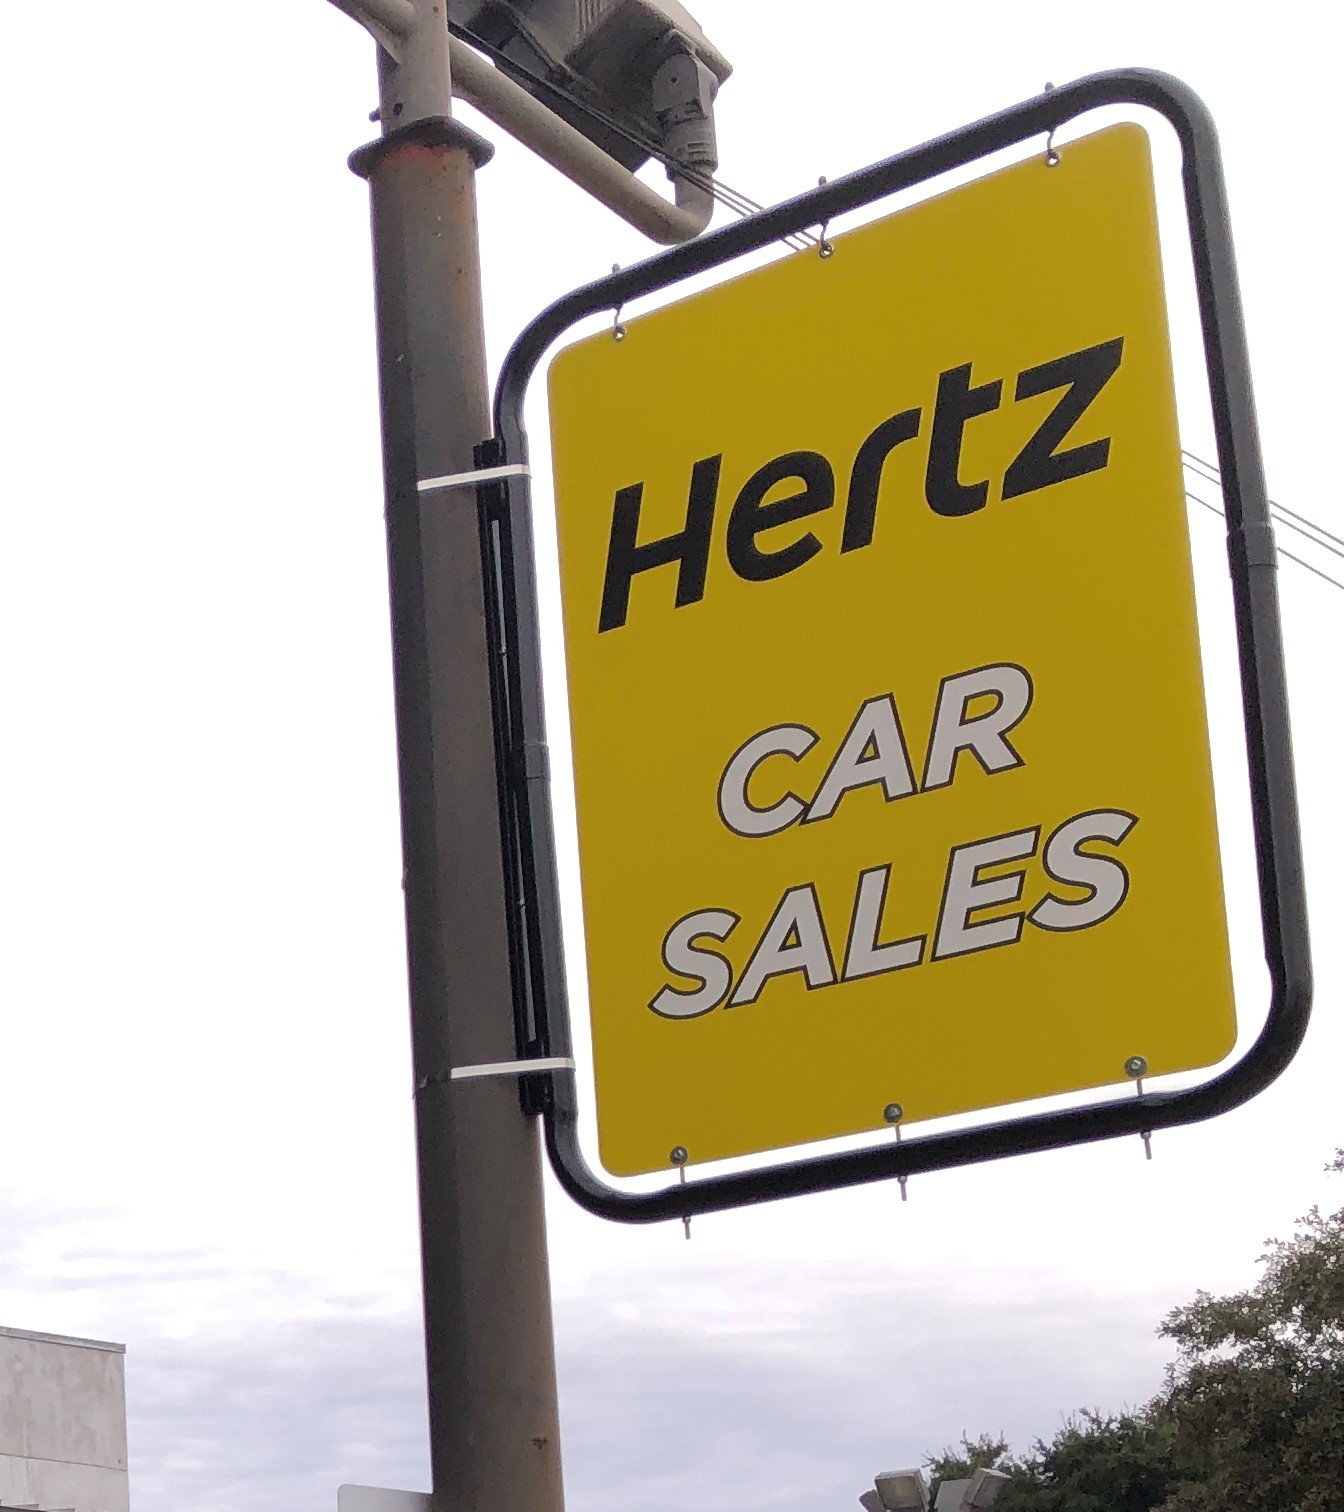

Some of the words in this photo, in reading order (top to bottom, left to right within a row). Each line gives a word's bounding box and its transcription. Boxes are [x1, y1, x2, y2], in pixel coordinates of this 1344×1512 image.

[597, 337, 1124, 633] Hertz
[717, 662, 1034, 839] CAR
[646, 808, 1140, 1020] SALES
